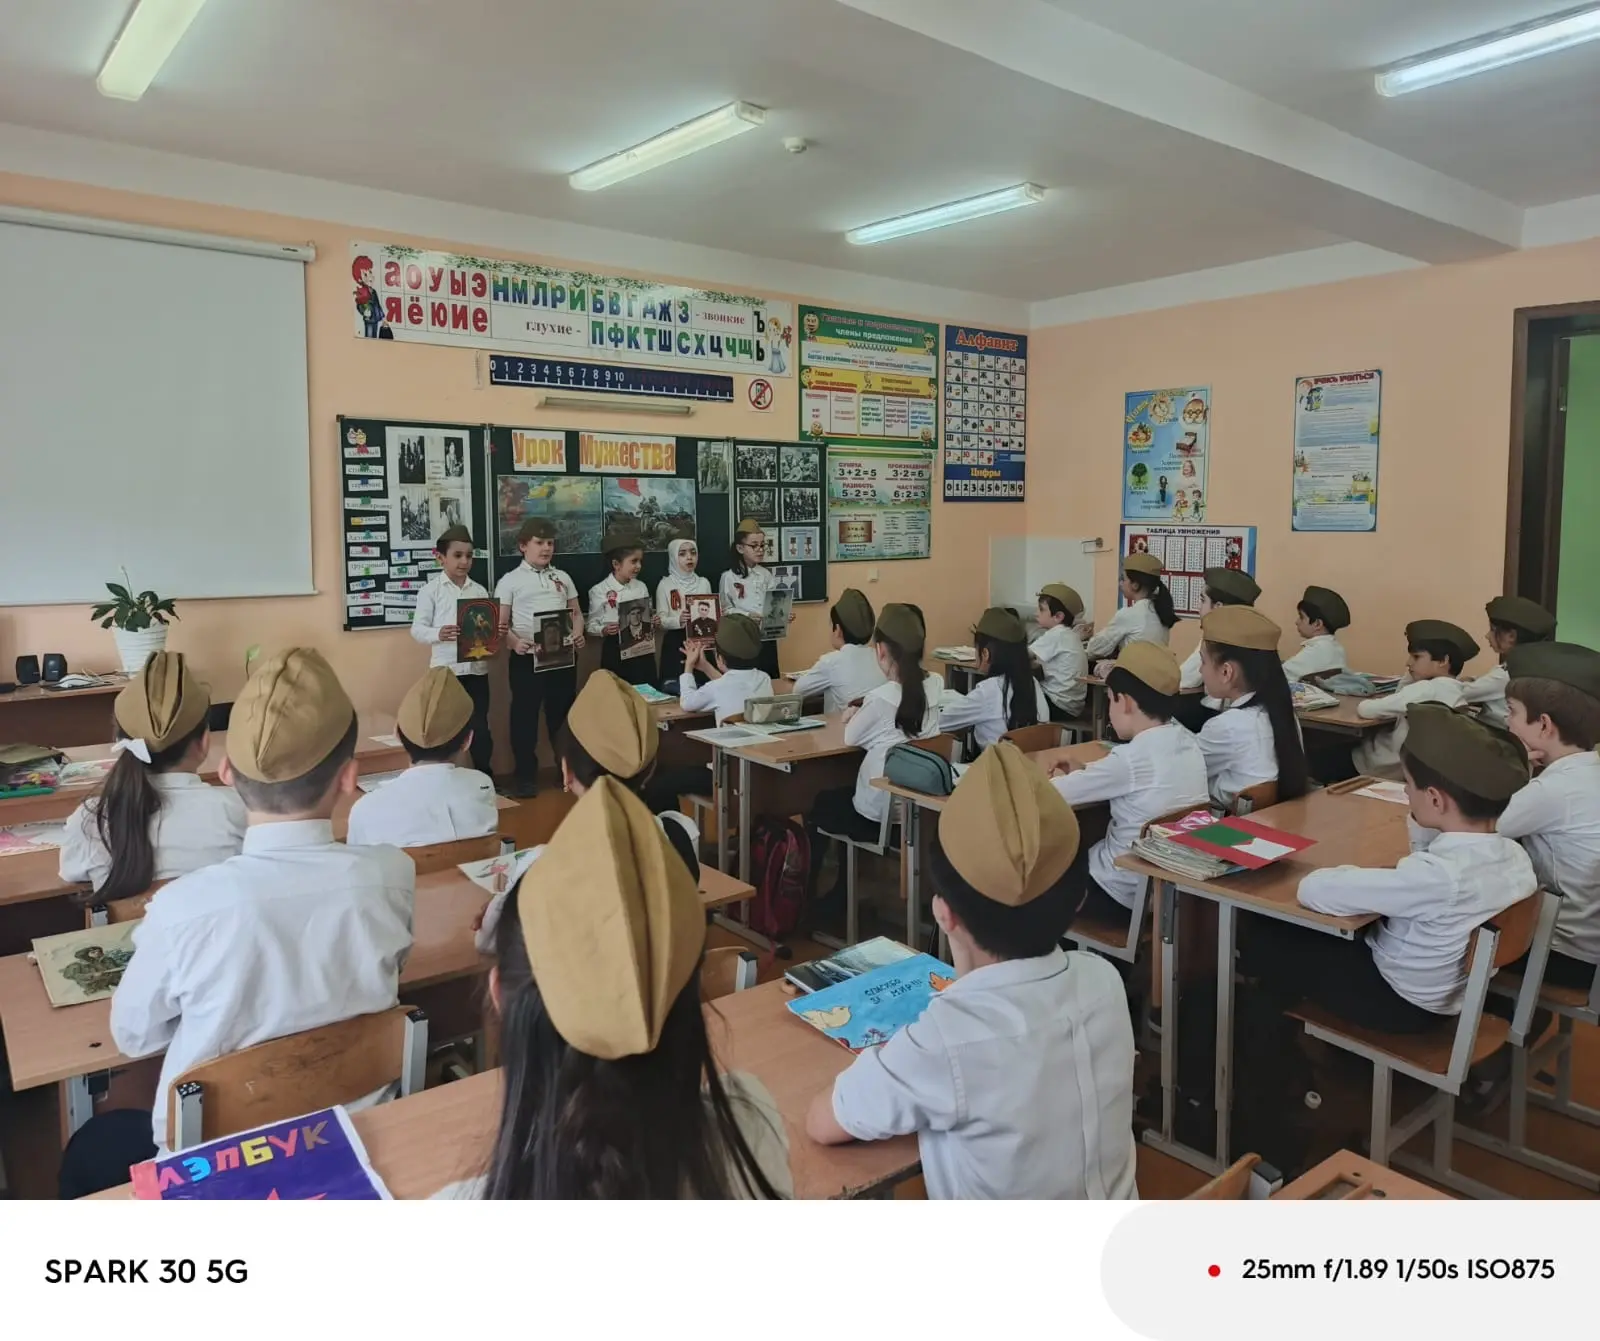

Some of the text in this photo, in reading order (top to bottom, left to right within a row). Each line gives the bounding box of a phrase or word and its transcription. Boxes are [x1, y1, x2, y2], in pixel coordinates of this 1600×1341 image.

[703, 311, 745, 324] звонкие
[526, 320, 572, 336] глухие
[956, 328, 1018, 351] Алфавит
[490, 360, 625, 382] 0 1 2 3 4 5 6 7 8 9 10
[512, 432, 675, 471] Урок Мужества
[971, 468, 1001, 477] Цифры
